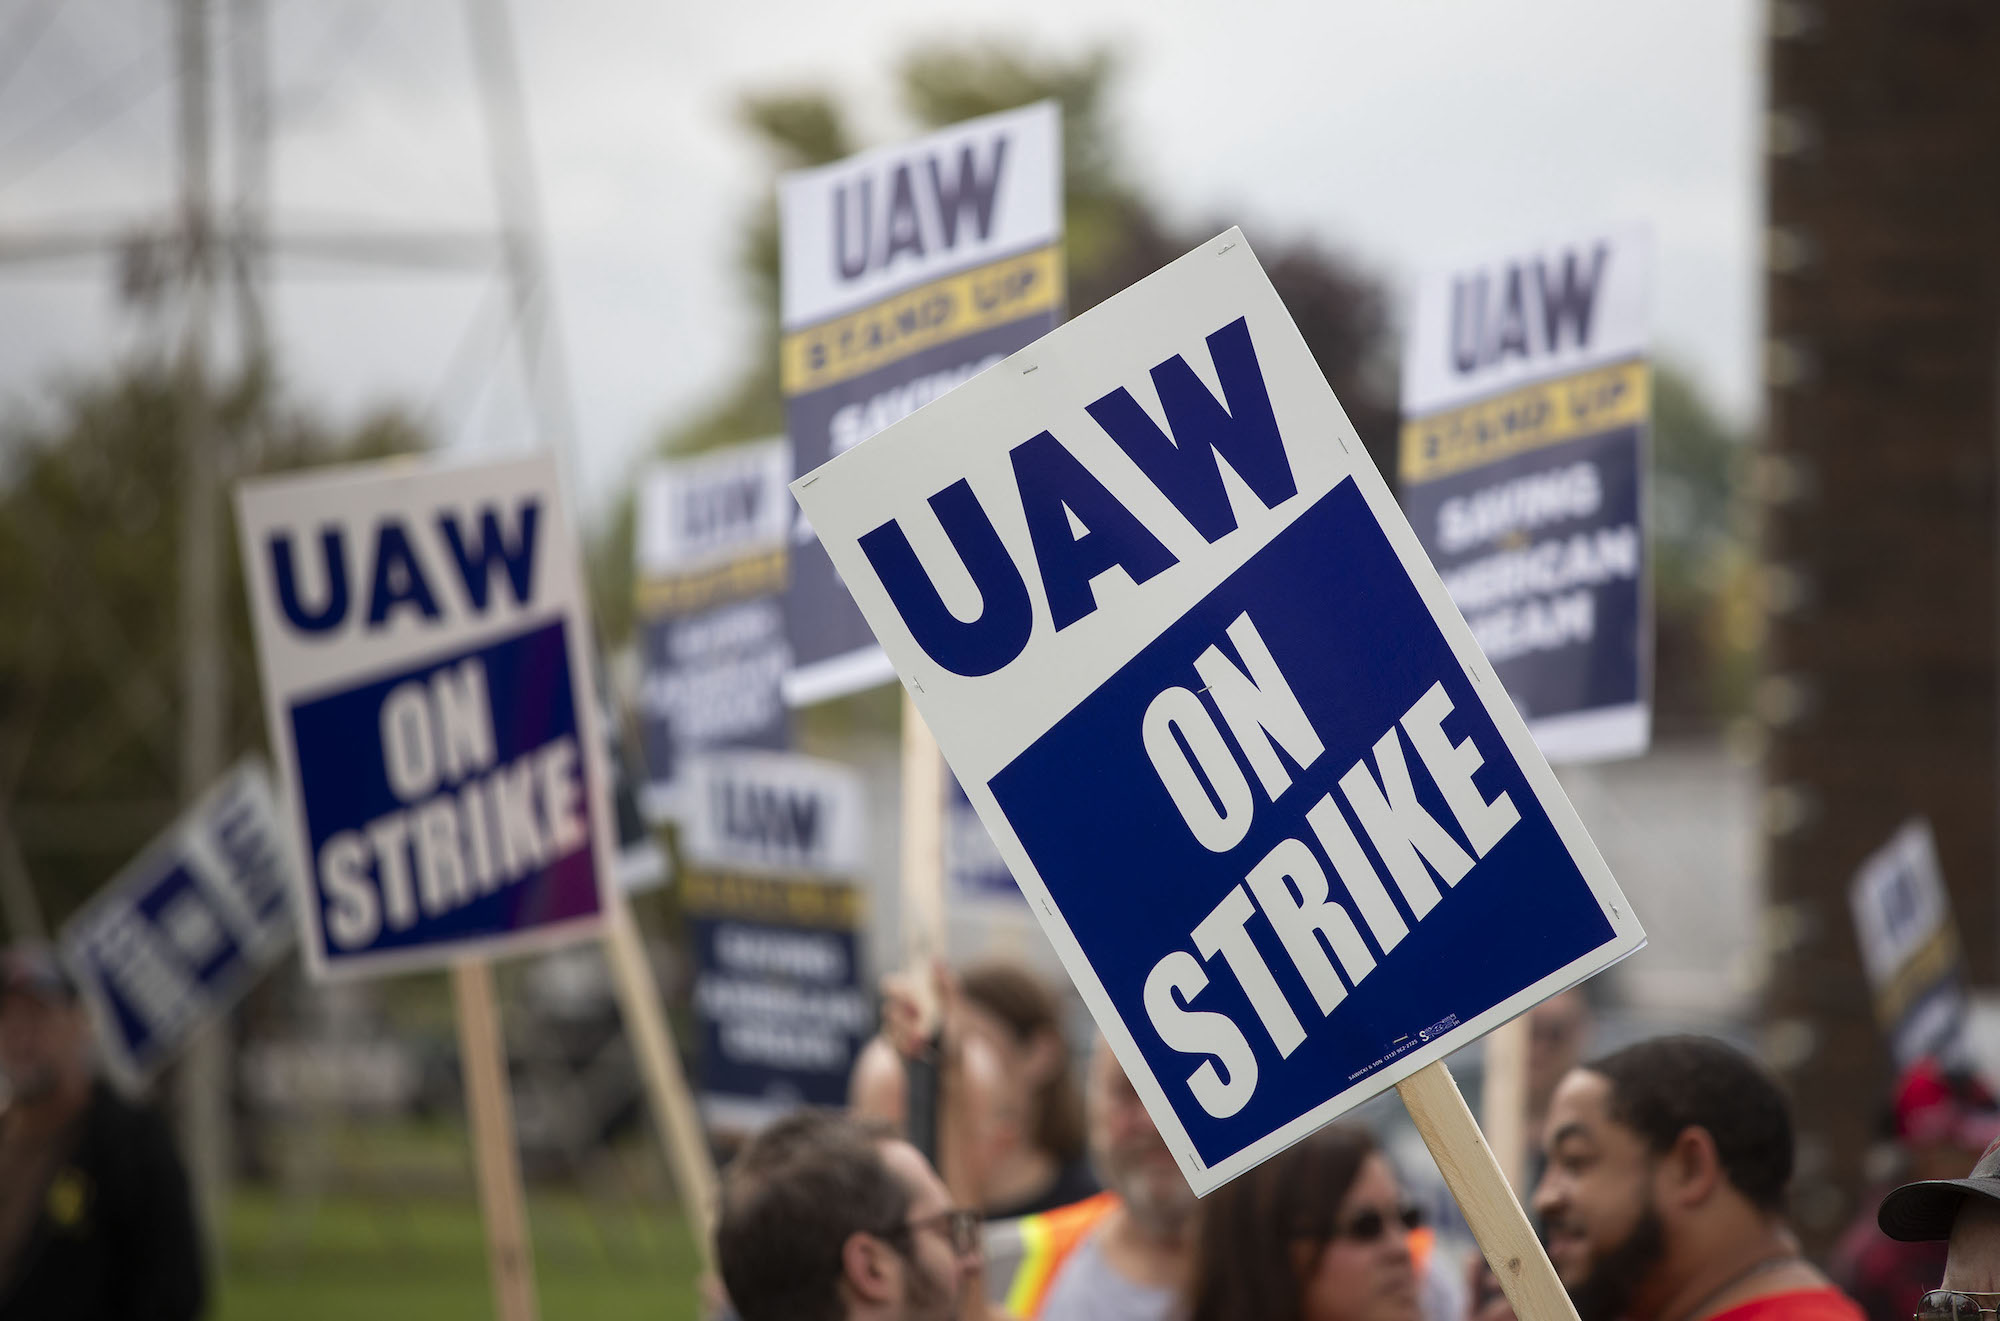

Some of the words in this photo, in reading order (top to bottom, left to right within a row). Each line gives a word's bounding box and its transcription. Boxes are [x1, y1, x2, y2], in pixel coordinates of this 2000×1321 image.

[834, 136, 1011, 282] UAW
[808, 292, 954, 372] STAND
[973, 264, 1039, 312] UP
[1449, 238, 1609, 374] UAW
[1424, 397, 1552, 462] STAND
[1569, 380, 1629, 420] UP
[857, 315, 1298, 677] UAW
[1437, 462, 1602, 553] SAVING
[267, 497, 541, 643] UAW
[379, 656, 497, 802] ON
[1142, 610, 1325, 853] ON
[317, 732, 587, 951] STRIKE
[1142, 680, 1522, 1120] STRIKE
[1372, 1058, 1384, 1068] SON
